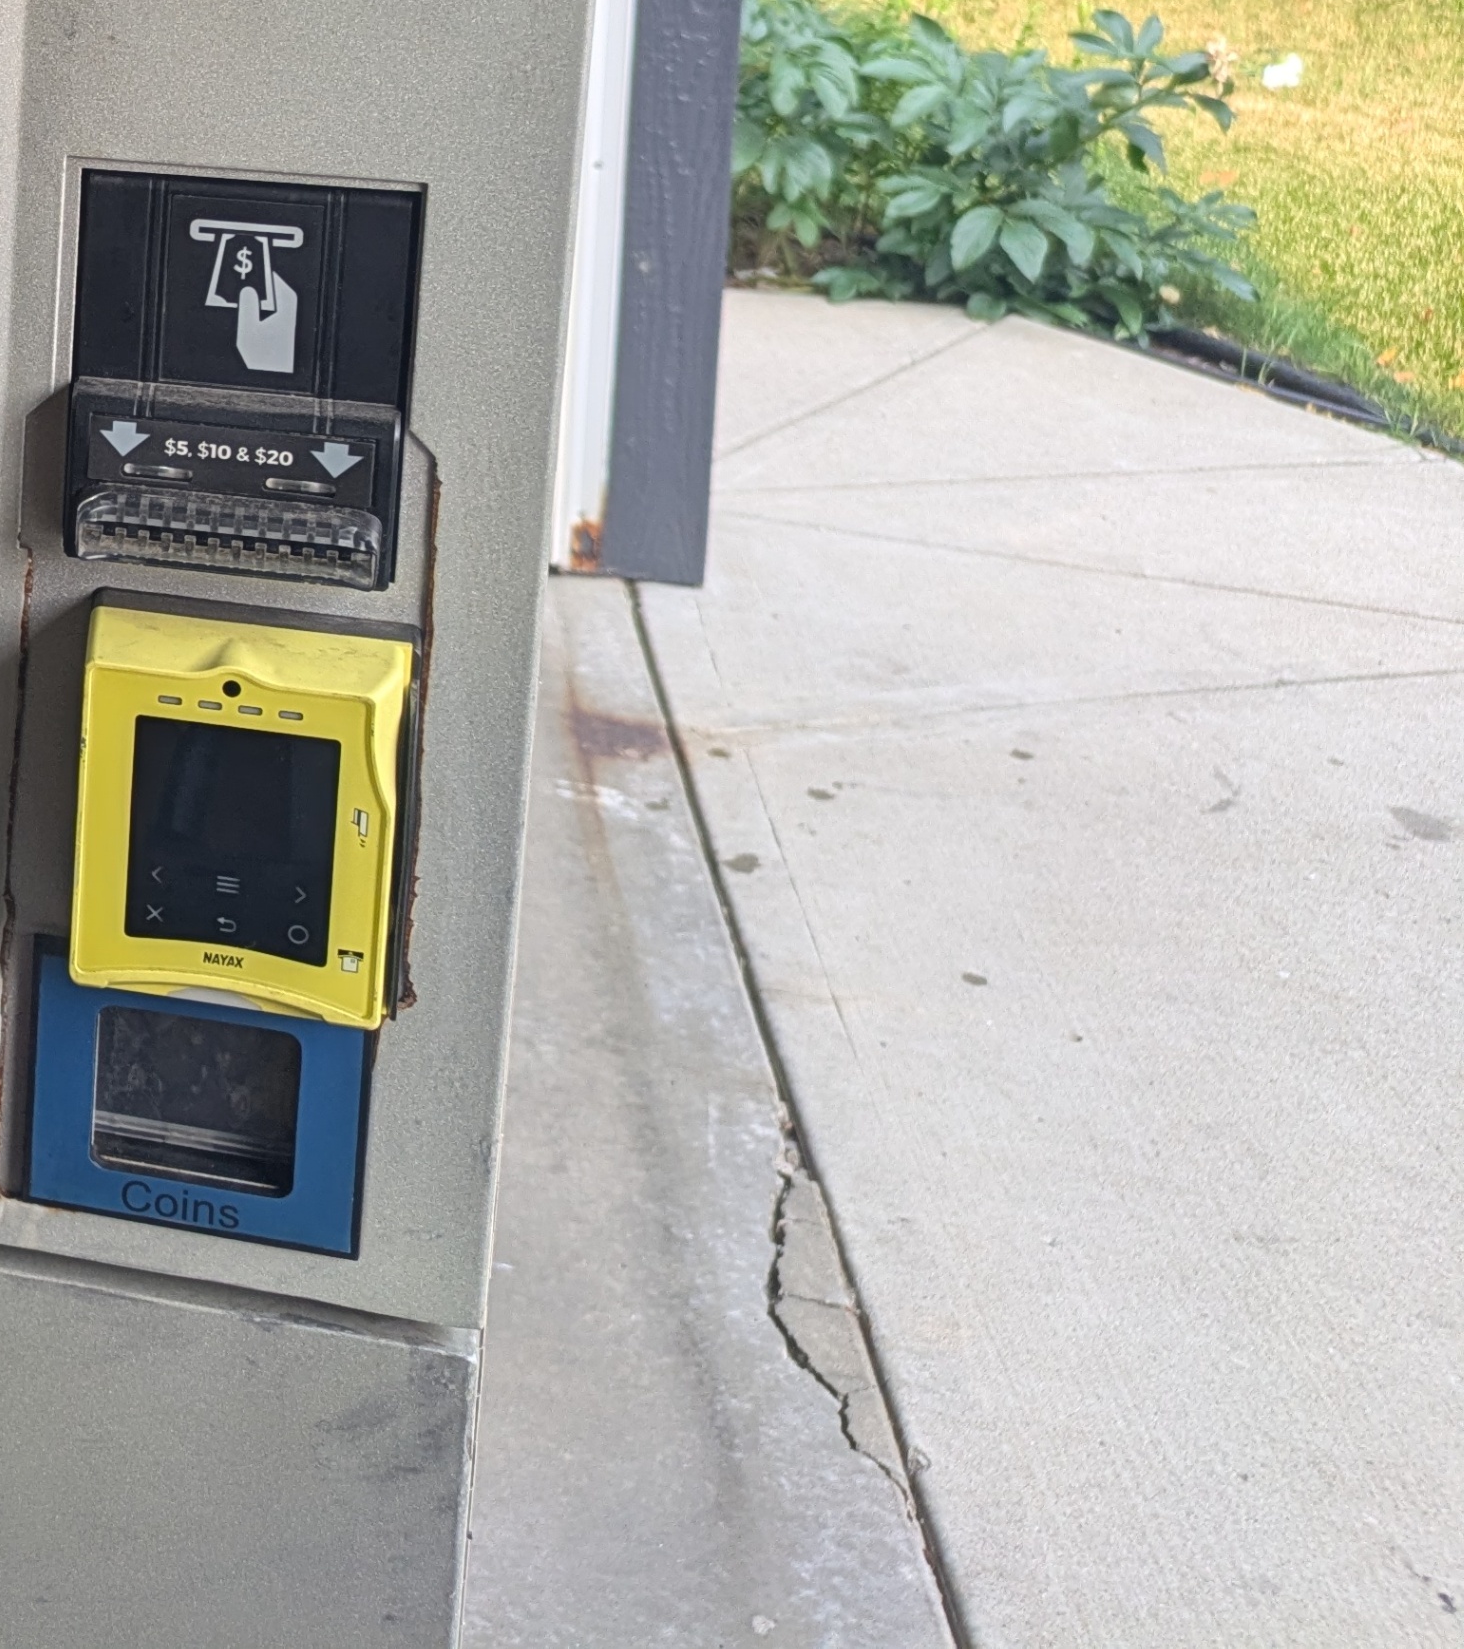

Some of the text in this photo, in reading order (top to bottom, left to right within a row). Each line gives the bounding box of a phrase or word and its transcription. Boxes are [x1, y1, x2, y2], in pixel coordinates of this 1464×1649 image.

[233, 246, 253, 279] $
[197, 440, 232, 461] $10
[236, 446, 251, 462] &
[255, 447, 294, 467] $20
[202, 951, 245, 969] NAYAX
[121, 1179, 240, 1229] Coins
